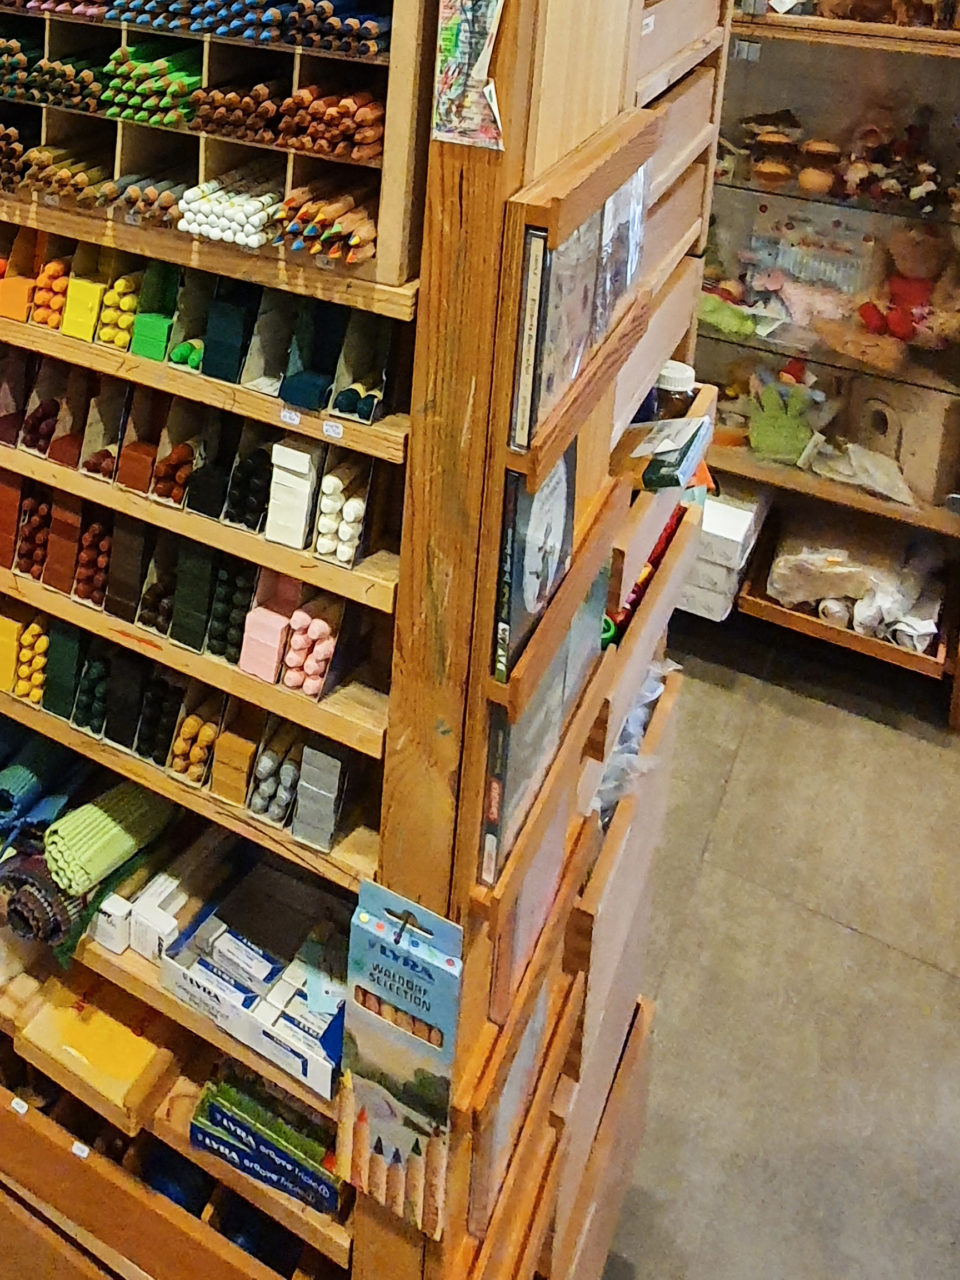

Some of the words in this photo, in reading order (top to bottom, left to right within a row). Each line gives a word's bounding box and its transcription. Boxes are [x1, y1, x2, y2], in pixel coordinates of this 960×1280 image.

[372, 962, 428, 997] WALDORF
[380, 944, 435, 982] LYRA
[189, 977, 221, 1004] LYRA
[368, 972, 431, 1012] SELECTION
[204, 1136, 239, 1164] LYRA
[222, 1118, 256, 1150] LYRA
